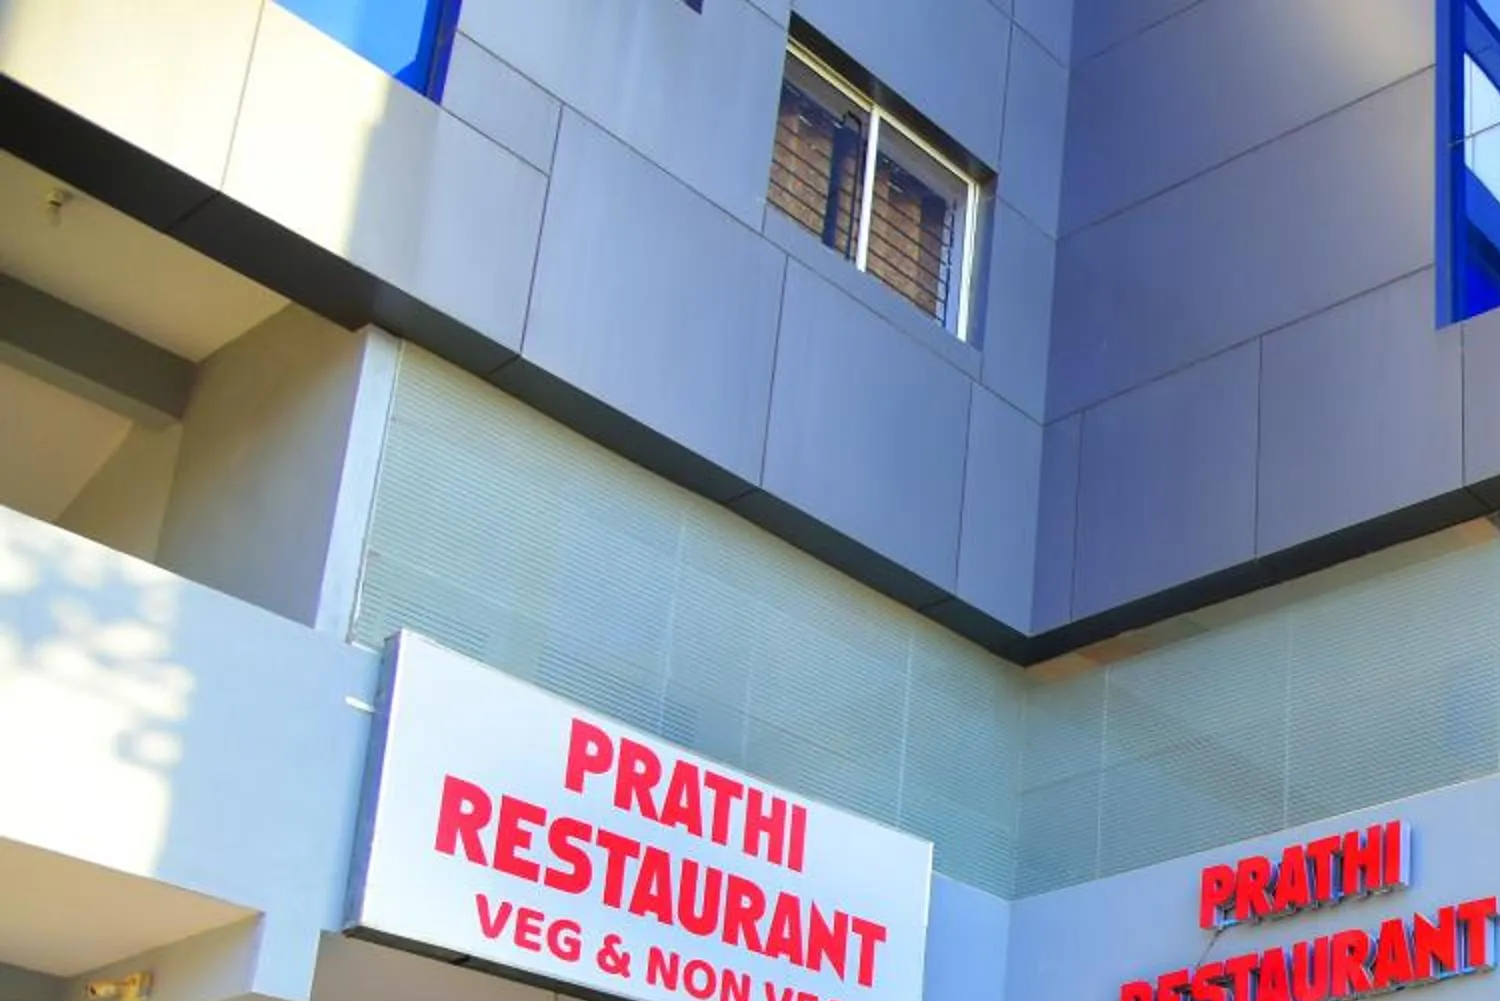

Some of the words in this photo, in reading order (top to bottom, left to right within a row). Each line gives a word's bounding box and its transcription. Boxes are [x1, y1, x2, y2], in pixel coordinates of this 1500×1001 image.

[564, 717, 808, 873] PRATHI
[434, 774, 888, 988] RESTAURANT
[476, 893, 582, 963] VEG
[596, 932, 632, 979] &
[1200, 820, 1408, 930] PRATHI
